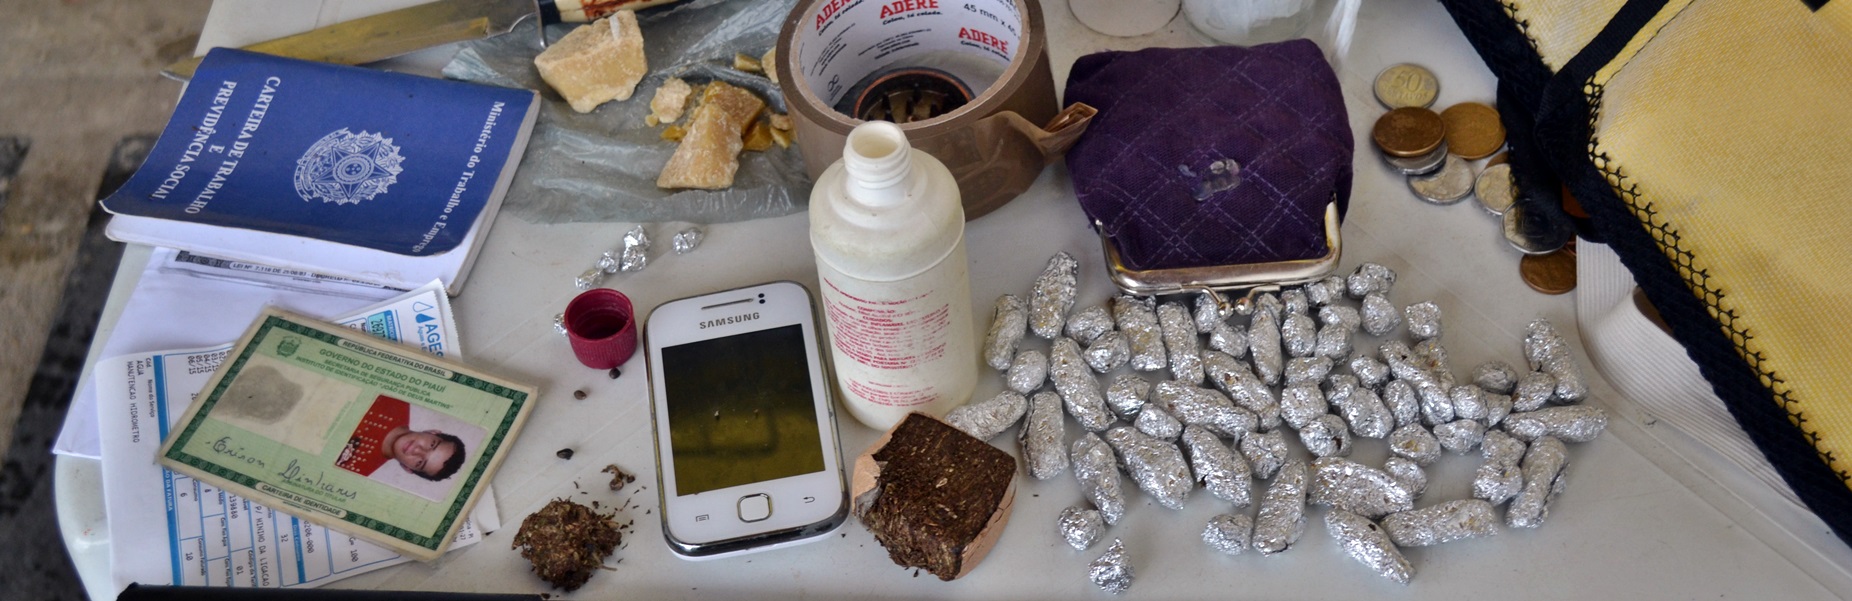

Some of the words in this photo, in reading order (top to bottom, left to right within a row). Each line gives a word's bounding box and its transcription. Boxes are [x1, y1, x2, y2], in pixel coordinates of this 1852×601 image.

[963, 3, 978, 13] 45
[979, 9, 999, 22] mm
[958, 27, 1009, 55] ADERE
[1392, 71, 1423, 92] 50
[180, 80, 238, 163] PREVIDÊNCIA
[238, 76, 281, 139] CARTEIRA
[474, 101, 506, 154] Ministério
[208, 144, 225, 154] E
[228, 141, 249, 158] DE
[467, 155, 480, 168] do
[184, 160, 238, 214] TRABALHO
[444, 170, 476, 214] Trabalho
[412, 221, 447, 253] Emprego
[700, 312, 760, 329] SAMSUNG
[425, 323, 444, 358] AGES
[188, 355, 197, 375] 06/15
[195, 355, 205, 374] 05/15
[203, 354, 212, 373] 04/15
[319, 348, 361, 368] GOVERNO
[361, 360, 374, 371] DO
[374, 364, 409, 382] ESTADO
[408, 374, 422, 386] DO
[423, 379, 447, 393] PIAUÍ
[343, 340, 378, 357] REPÚBLICA
[377, 351, 415, 367] FEDERATIVA
[415, 362, 424, 370] DO
[424, 365, 447, 377] BRASIL
[127, 361, 137, 400] MANUTENCAO
[296, 356, 326, 371] INSTITUTO
[325, 365, 335, 373] DE
[334, 368, 378, 387] IDENTIFICAÇÃO
[397, 388, 407, 397] DE
[407, 391, 425, 403] DEUS
[324, 359, 361, 374] SECRETARIA
[360, 370, 369, 378] DE
[369, 373, 404, 390] SEGURANÇA
[404, 383, 431, 397] PÚBLICA
[130, 402, 140, 443] HIDROMETRO
[165, 479, 171, 487] DA
[262, 484, 294, 500] CARTEIRA
[293, 495, 303, 503] DE
[303, 498, 342, 516] IDENTIDADE
[256, 517, 265, 543] MINIMO
[280, 533, 289, 543] 32
[185, 552, 194, 561] 10
[259, 545, 267, 555] DA
[236, 565, 244, 575] 01
[260, 557, 270, 587] LIGACAO
